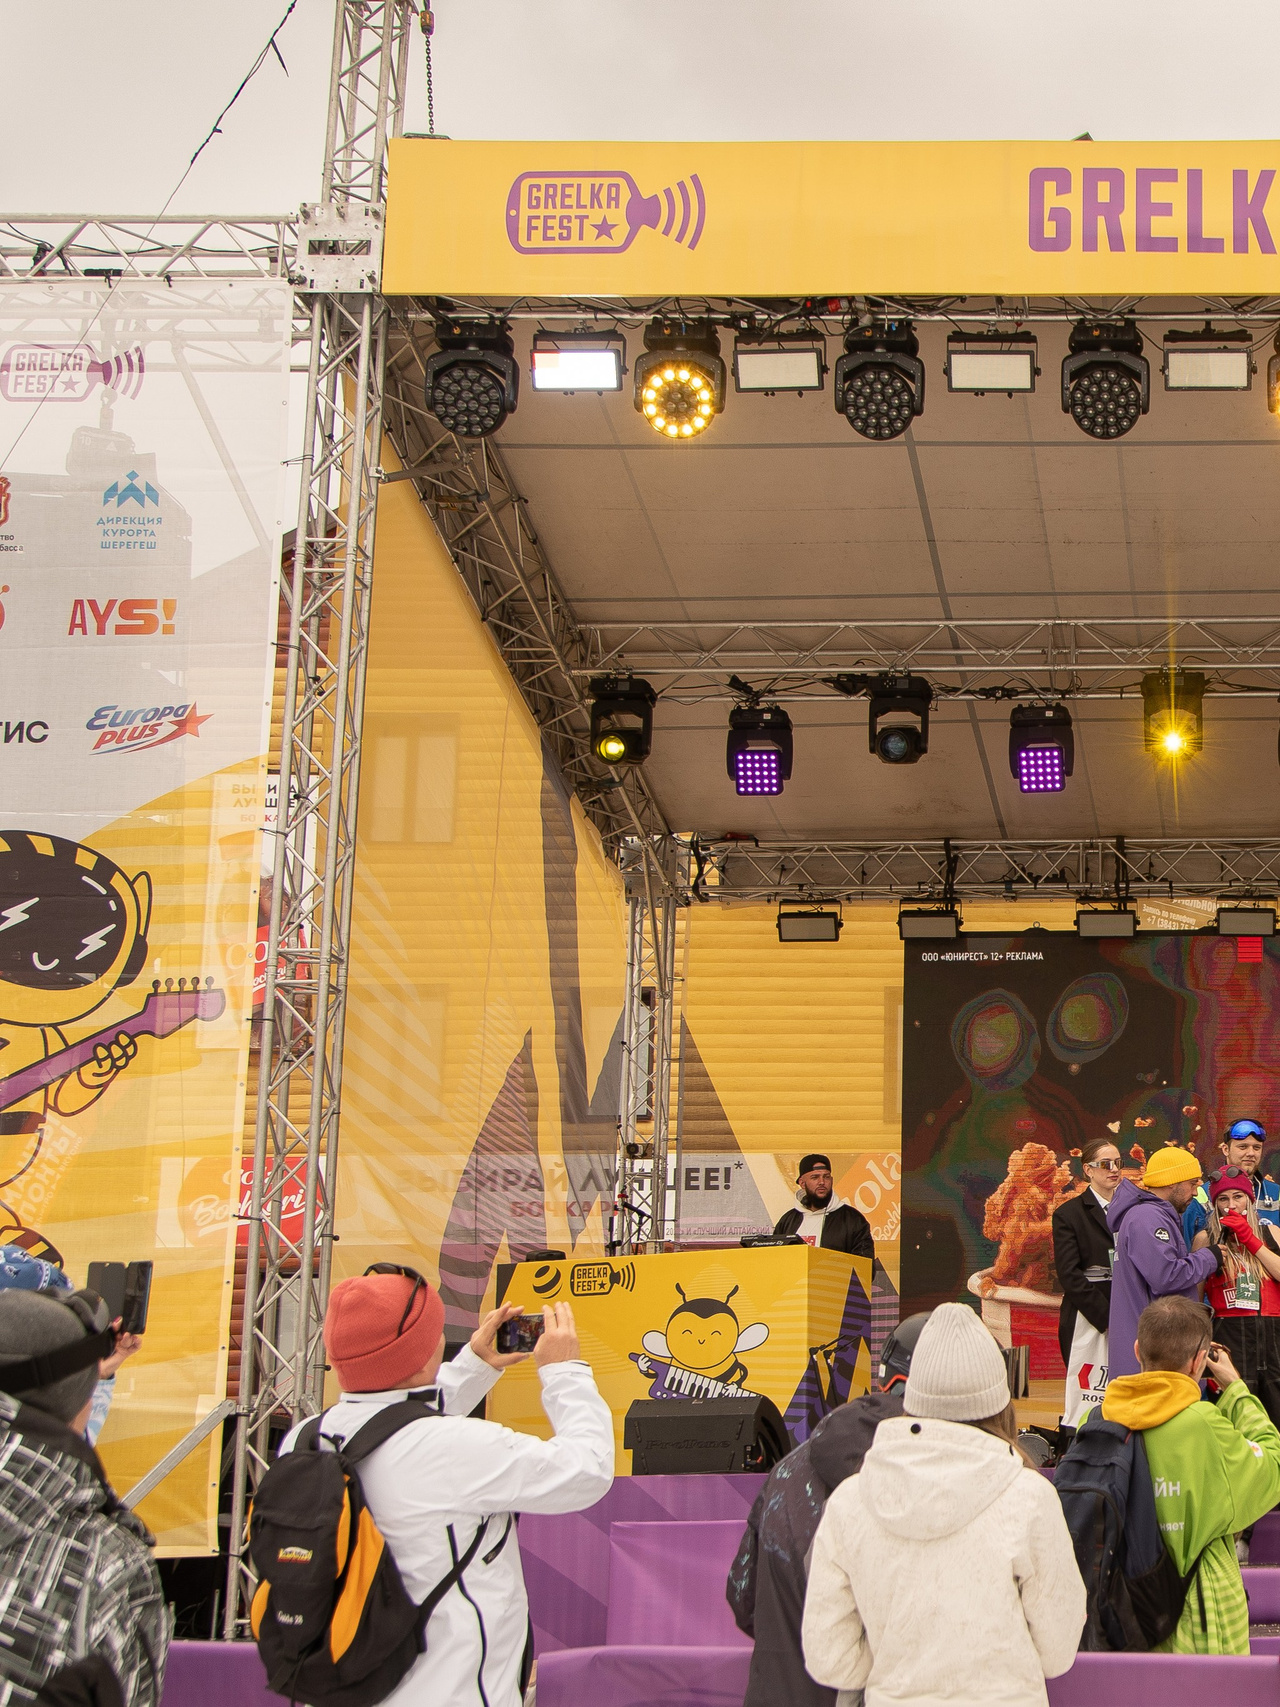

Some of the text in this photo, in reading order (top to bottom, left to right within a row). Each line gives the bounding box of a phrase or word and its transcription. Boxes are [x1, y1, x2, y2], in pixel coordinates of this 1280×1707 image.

[527, 182, 621, 210] GRELKA
[526, 214, 590, 242] FEST
[15, 352, 84, 372] GRELKA
[13, 374, 57, 394] FEST
[96, 516, 163, 527] ДИРЕКЦИЯ
[102, 528, 157, 538] КУРОРТА
[100, 540, 157, 550] ШЕРЕГЕШ
[68, 598, 178, 636] AYS!
[0, 719, 50, 744] ИС
[940, 952, 988, 961] «ЮНИРЕСТ»
[991, 952, 1003, 961] 12+
[1006, 952, 1044, 961] РЕКЛАМА
[840, 1151, 901, 1214] ola
[576, 1267, 608, 1280] GRELKA
[576, 1280, 599, 1292] FEST
[1082, 1393, 1105, 1404] ROS
